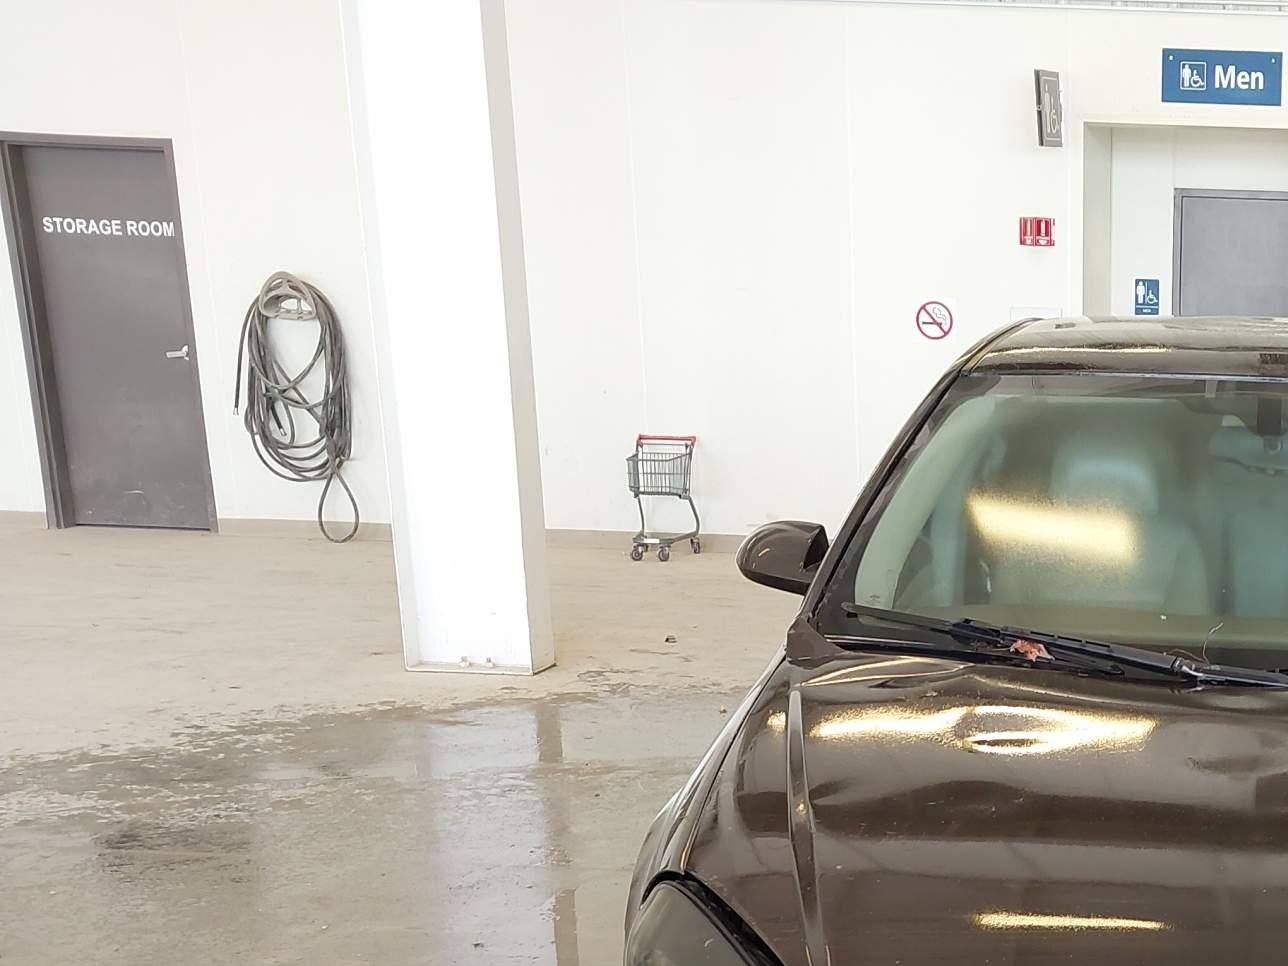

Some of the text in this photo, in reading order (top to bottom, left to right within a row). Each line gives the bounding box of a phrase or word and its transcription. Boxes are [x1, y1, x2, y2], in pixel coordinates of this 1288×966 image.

[1214, 64, 1264, 90] Men
[42, 216, 176, 237] STORAGE ROOM
